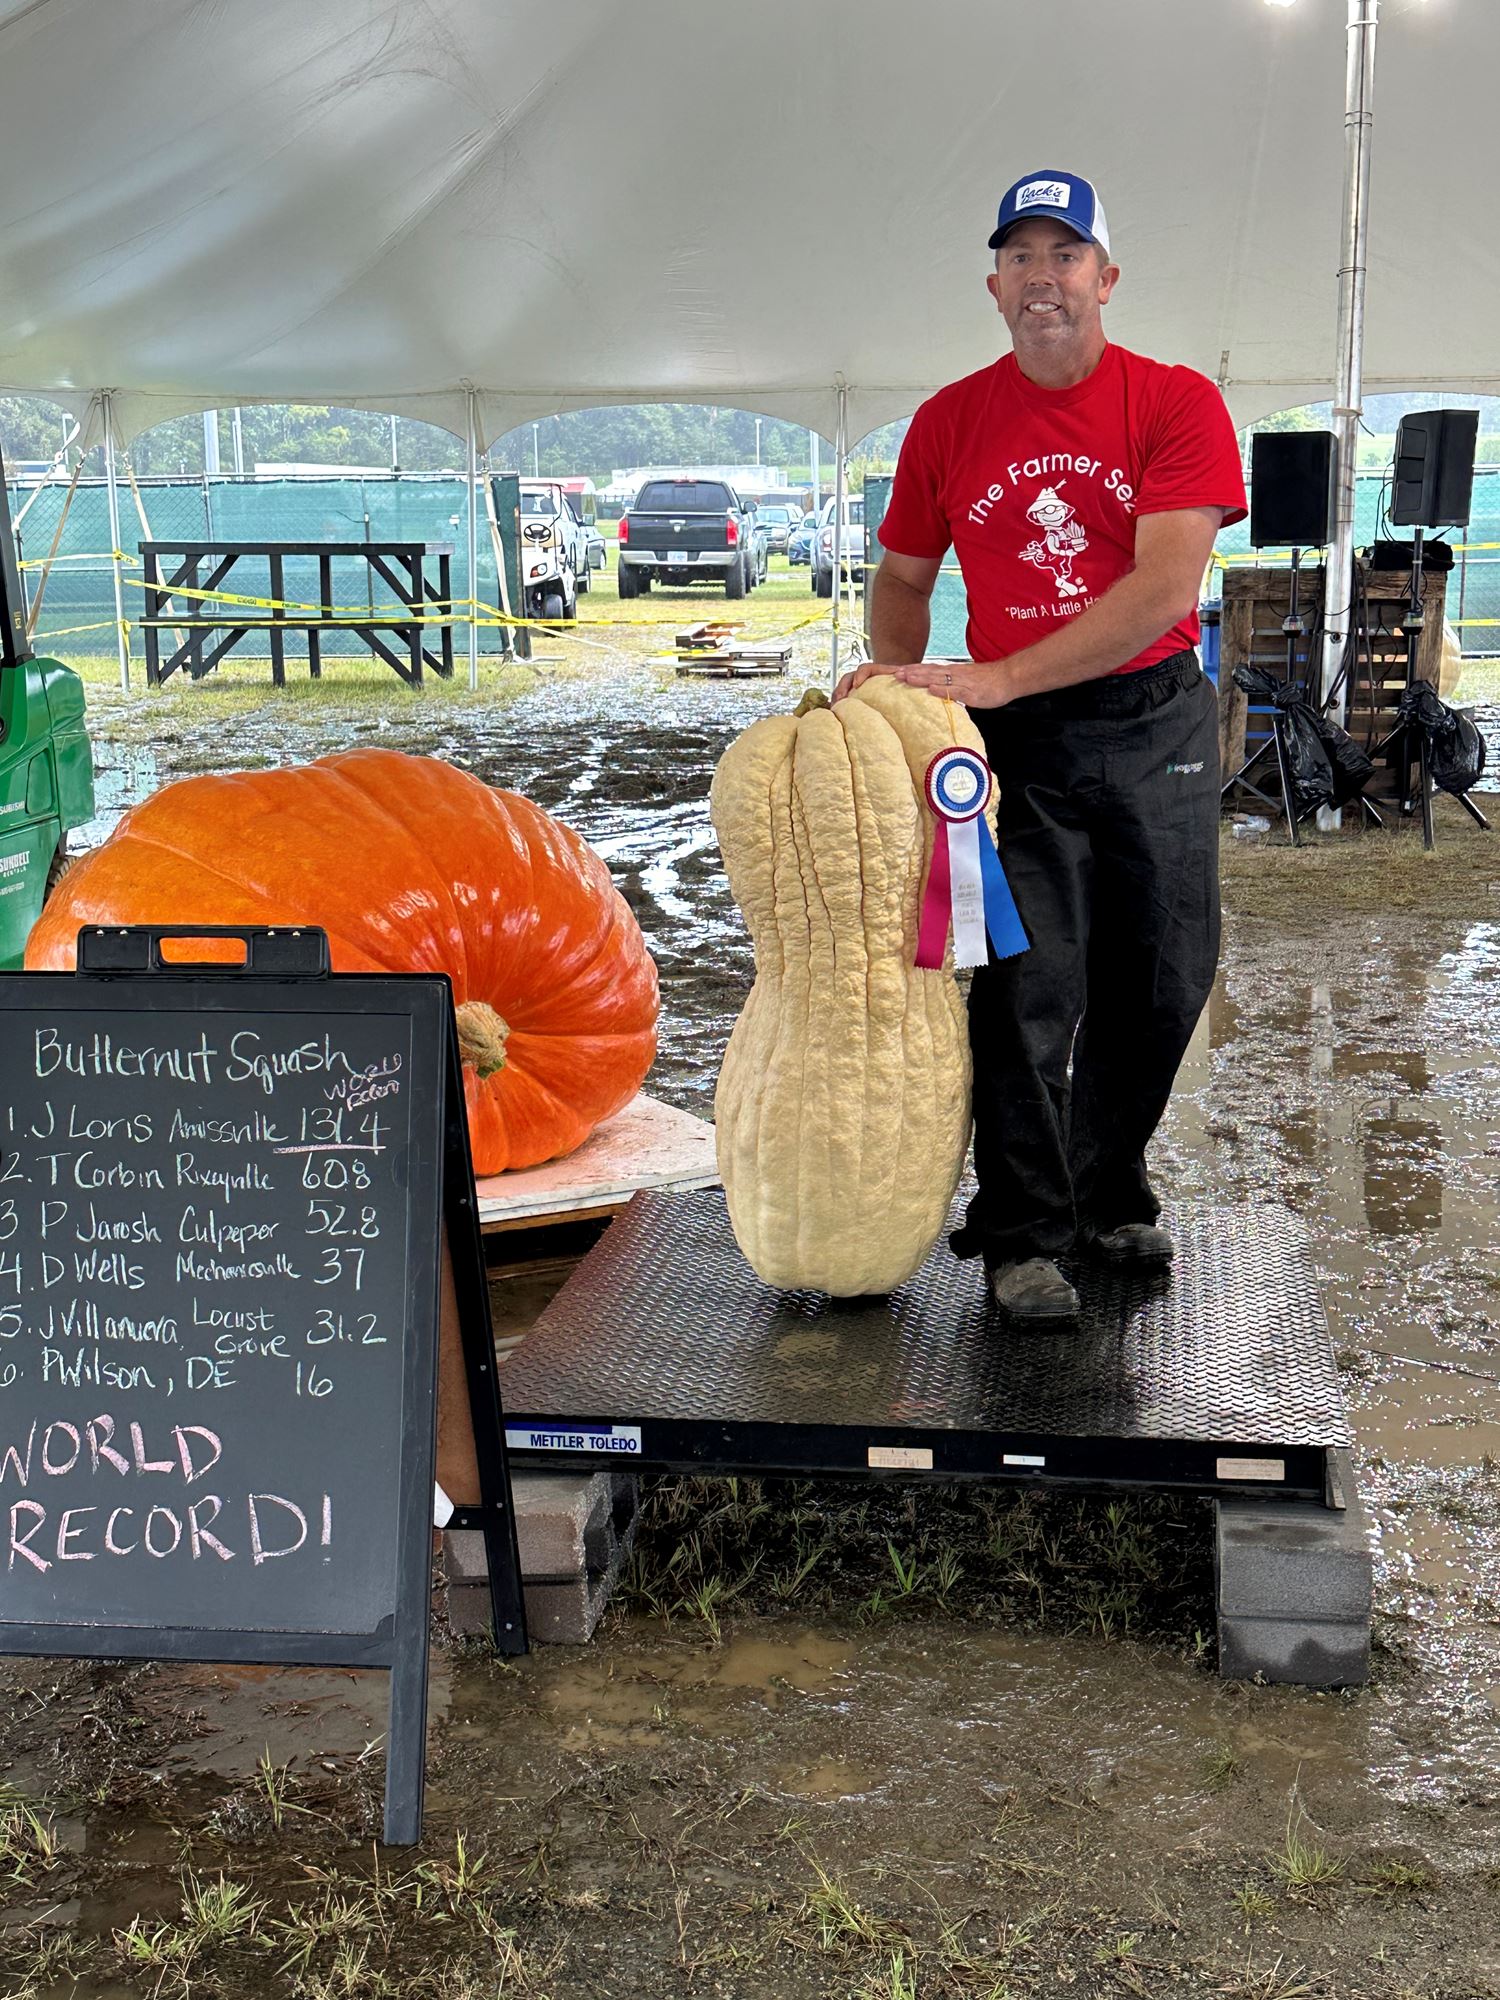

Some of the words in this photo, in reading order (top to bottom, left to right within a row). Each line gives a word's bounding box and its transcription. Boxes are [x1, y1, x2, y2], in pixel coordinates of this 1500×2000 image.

[968, 483, 1004, 525] The
[1007, 453, 1102, 486] Farmer
[1041, 606, 1050, 616] A
[1052, 601, 1081, 617] Little
[35, 1028, 218, 1084] Butternut
[226, 1031, 355, 1095] Squash
[9, 1106, 28, 1138] 1.
[31, 1101, 55, 1138] J
[69, 1104, 153, 1143] Loris
[300, 1107, 391, 1155] 131.4
[0, 1151, 33, 1183] 2.
[35, 1152, 72, 1186] T
[74, 1151, 164, 1189] Corbin
[41, 1200, 68, 1240] P
[76, 1201, 162, 1243] Jarosh
[305, 1199, 380, 1238] 52.8
[0, 1250, 34, 1294] 4.
[42, 1251, 65, 1289] D
[74, 1248, 145, 1290] Wells
[313, 1248, 365, 1291] 37
[0, 1303, 32, 1338] 5.
[193, 1297, 275, 1331] Locust
[306, 1309, 387, 1344] 31.2
[214, 1334, 291, 1358] Grove
[185, 1356, 239, 1389] DE
[296, 1361, 334, 1397] 16
[0, 1413, 223, 1487] WORLD
[529, 1434, 585, 1449] METTLER
[589, 1436, 637, 1451] TOLEDO
[8, 1494, 332, 1573] RECORD!
